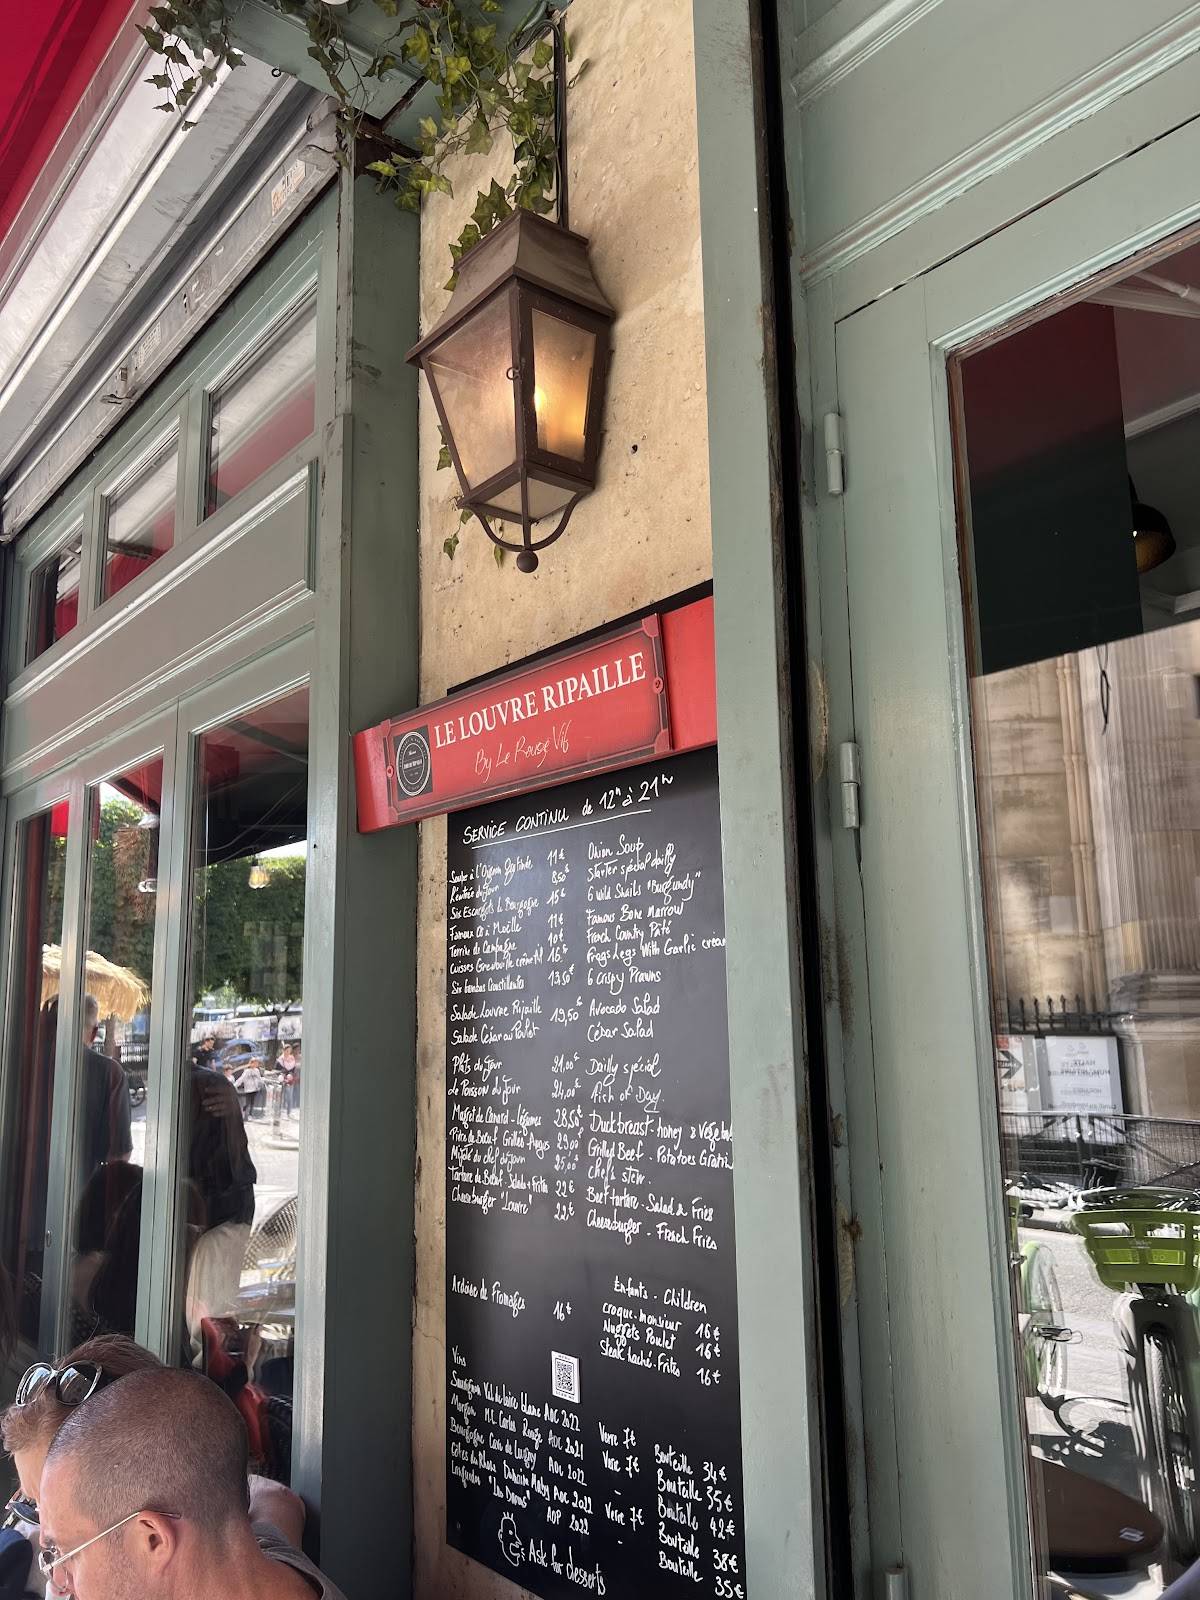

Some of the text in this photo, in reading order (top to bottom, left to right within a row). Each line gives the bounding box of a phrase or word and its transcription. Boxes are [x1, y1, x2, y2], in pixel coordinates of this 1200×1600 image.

[434, 651, 646, 748] LE LOUVRE RIPAILLE
[475, 748, 492, 783] By
[496, 743, 511, 767] Le
[462, 820, 507, 844] SERVICE
[515, 808, 570, 832] CONTINU
[582, 798, 594, 816] de
[616, 834, 644, 862] Soup
[587, 886, 594, 901] 6
[588, 968, 594, 985] 6
[631, 993, 660, 1015] Salad
[621, 1017, 654, 1038] Salad
[617, 1140, 644, 1161] Beef
[664, 1288, 707, 1314] Children
